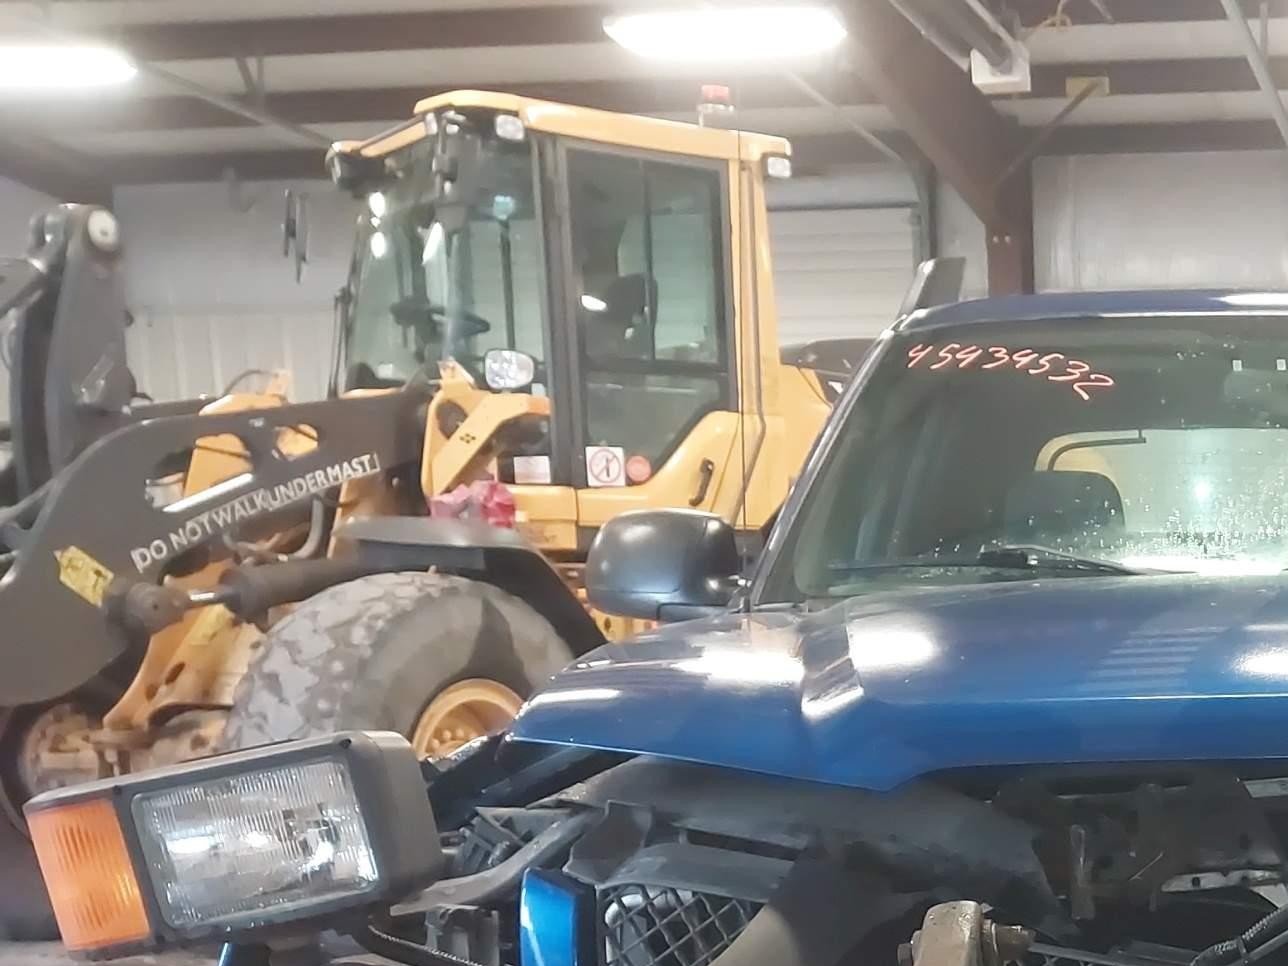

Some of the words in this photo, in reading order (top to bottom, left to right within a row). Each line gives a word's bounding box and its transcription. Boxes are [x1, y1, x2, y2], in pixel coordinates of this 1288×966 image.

[907, 343, 1115, 401] 45434532
[130, 541, 168, 573] DO
[169, 515, 212, 551] NOT
[211, 490, 269, 529] WALK
[267, 472, 327, 509] UNDER
[325, 454, 372, 485] MAST
